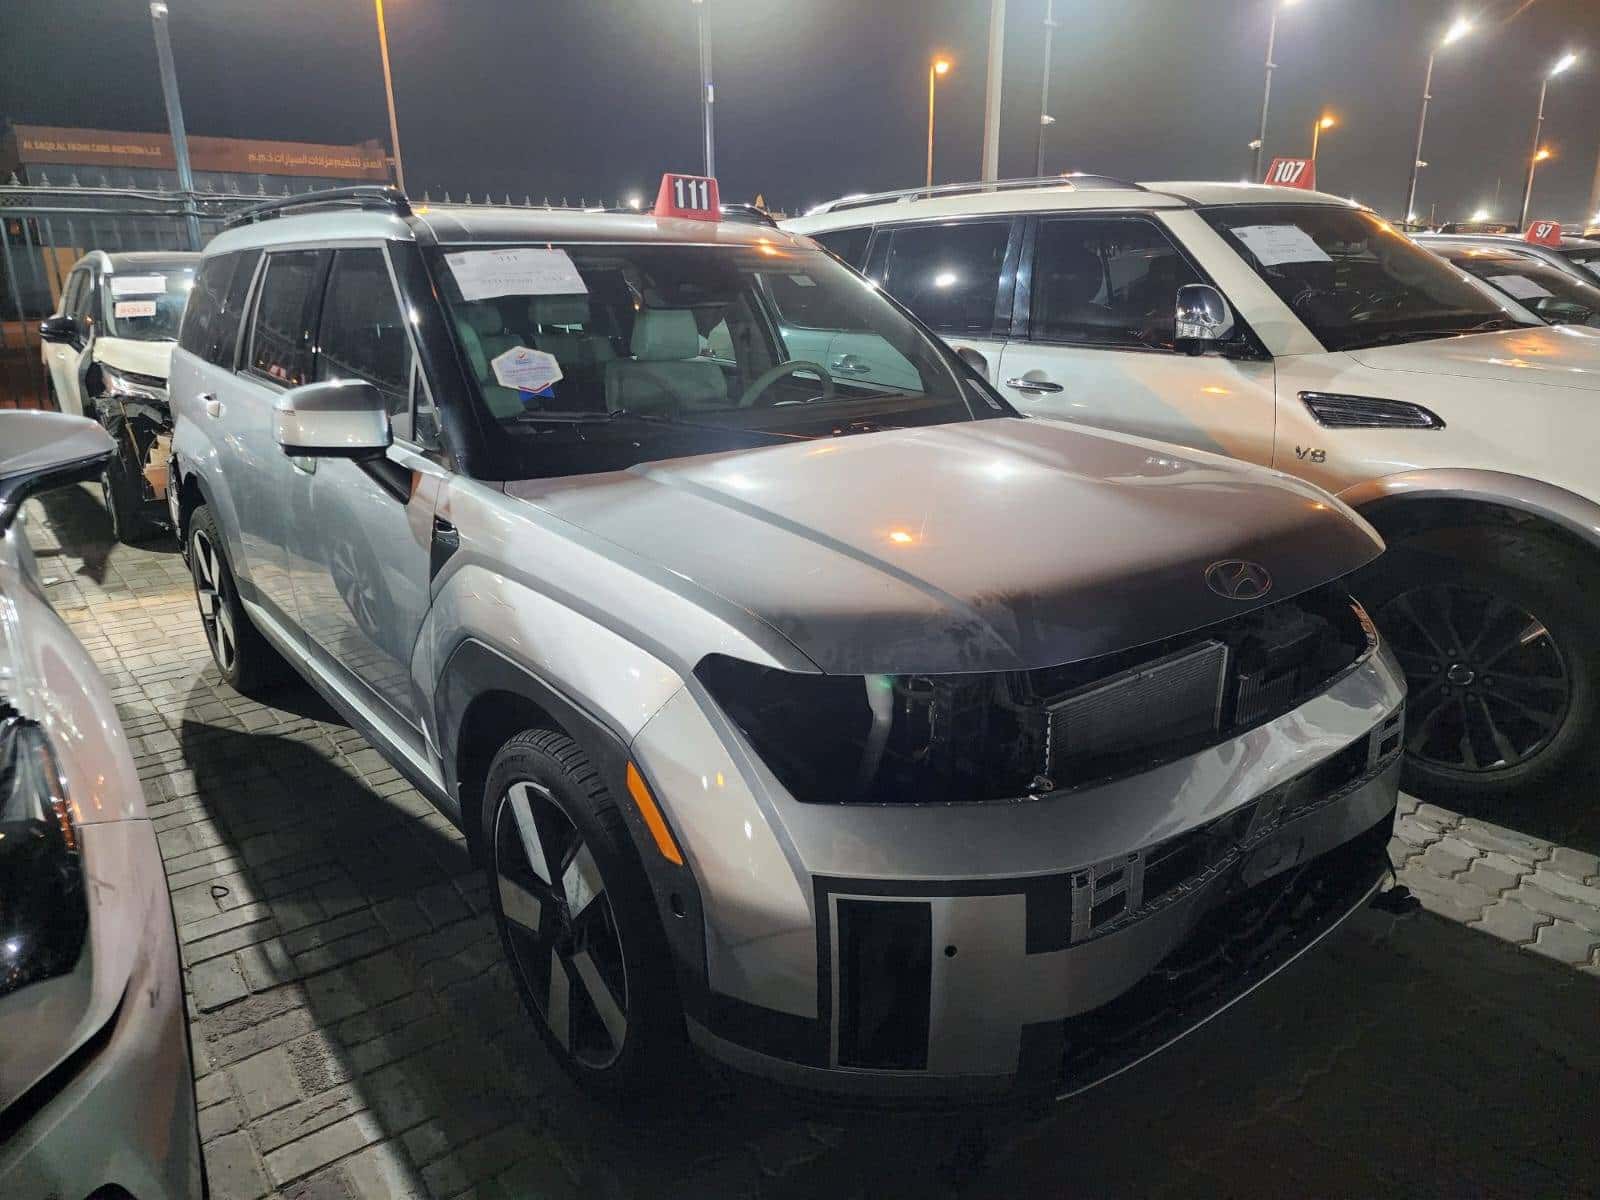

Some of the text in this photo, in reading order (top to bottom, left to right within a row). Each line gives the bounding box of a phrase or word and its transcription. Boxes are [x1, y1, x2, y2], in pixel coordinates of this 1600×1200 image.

[1274, 161, 1306, 183] 107
[675, 178, 708, 210] 111
[1535, 223, 1553, 239] 97
[1294, 445, 1327, 464] V8
